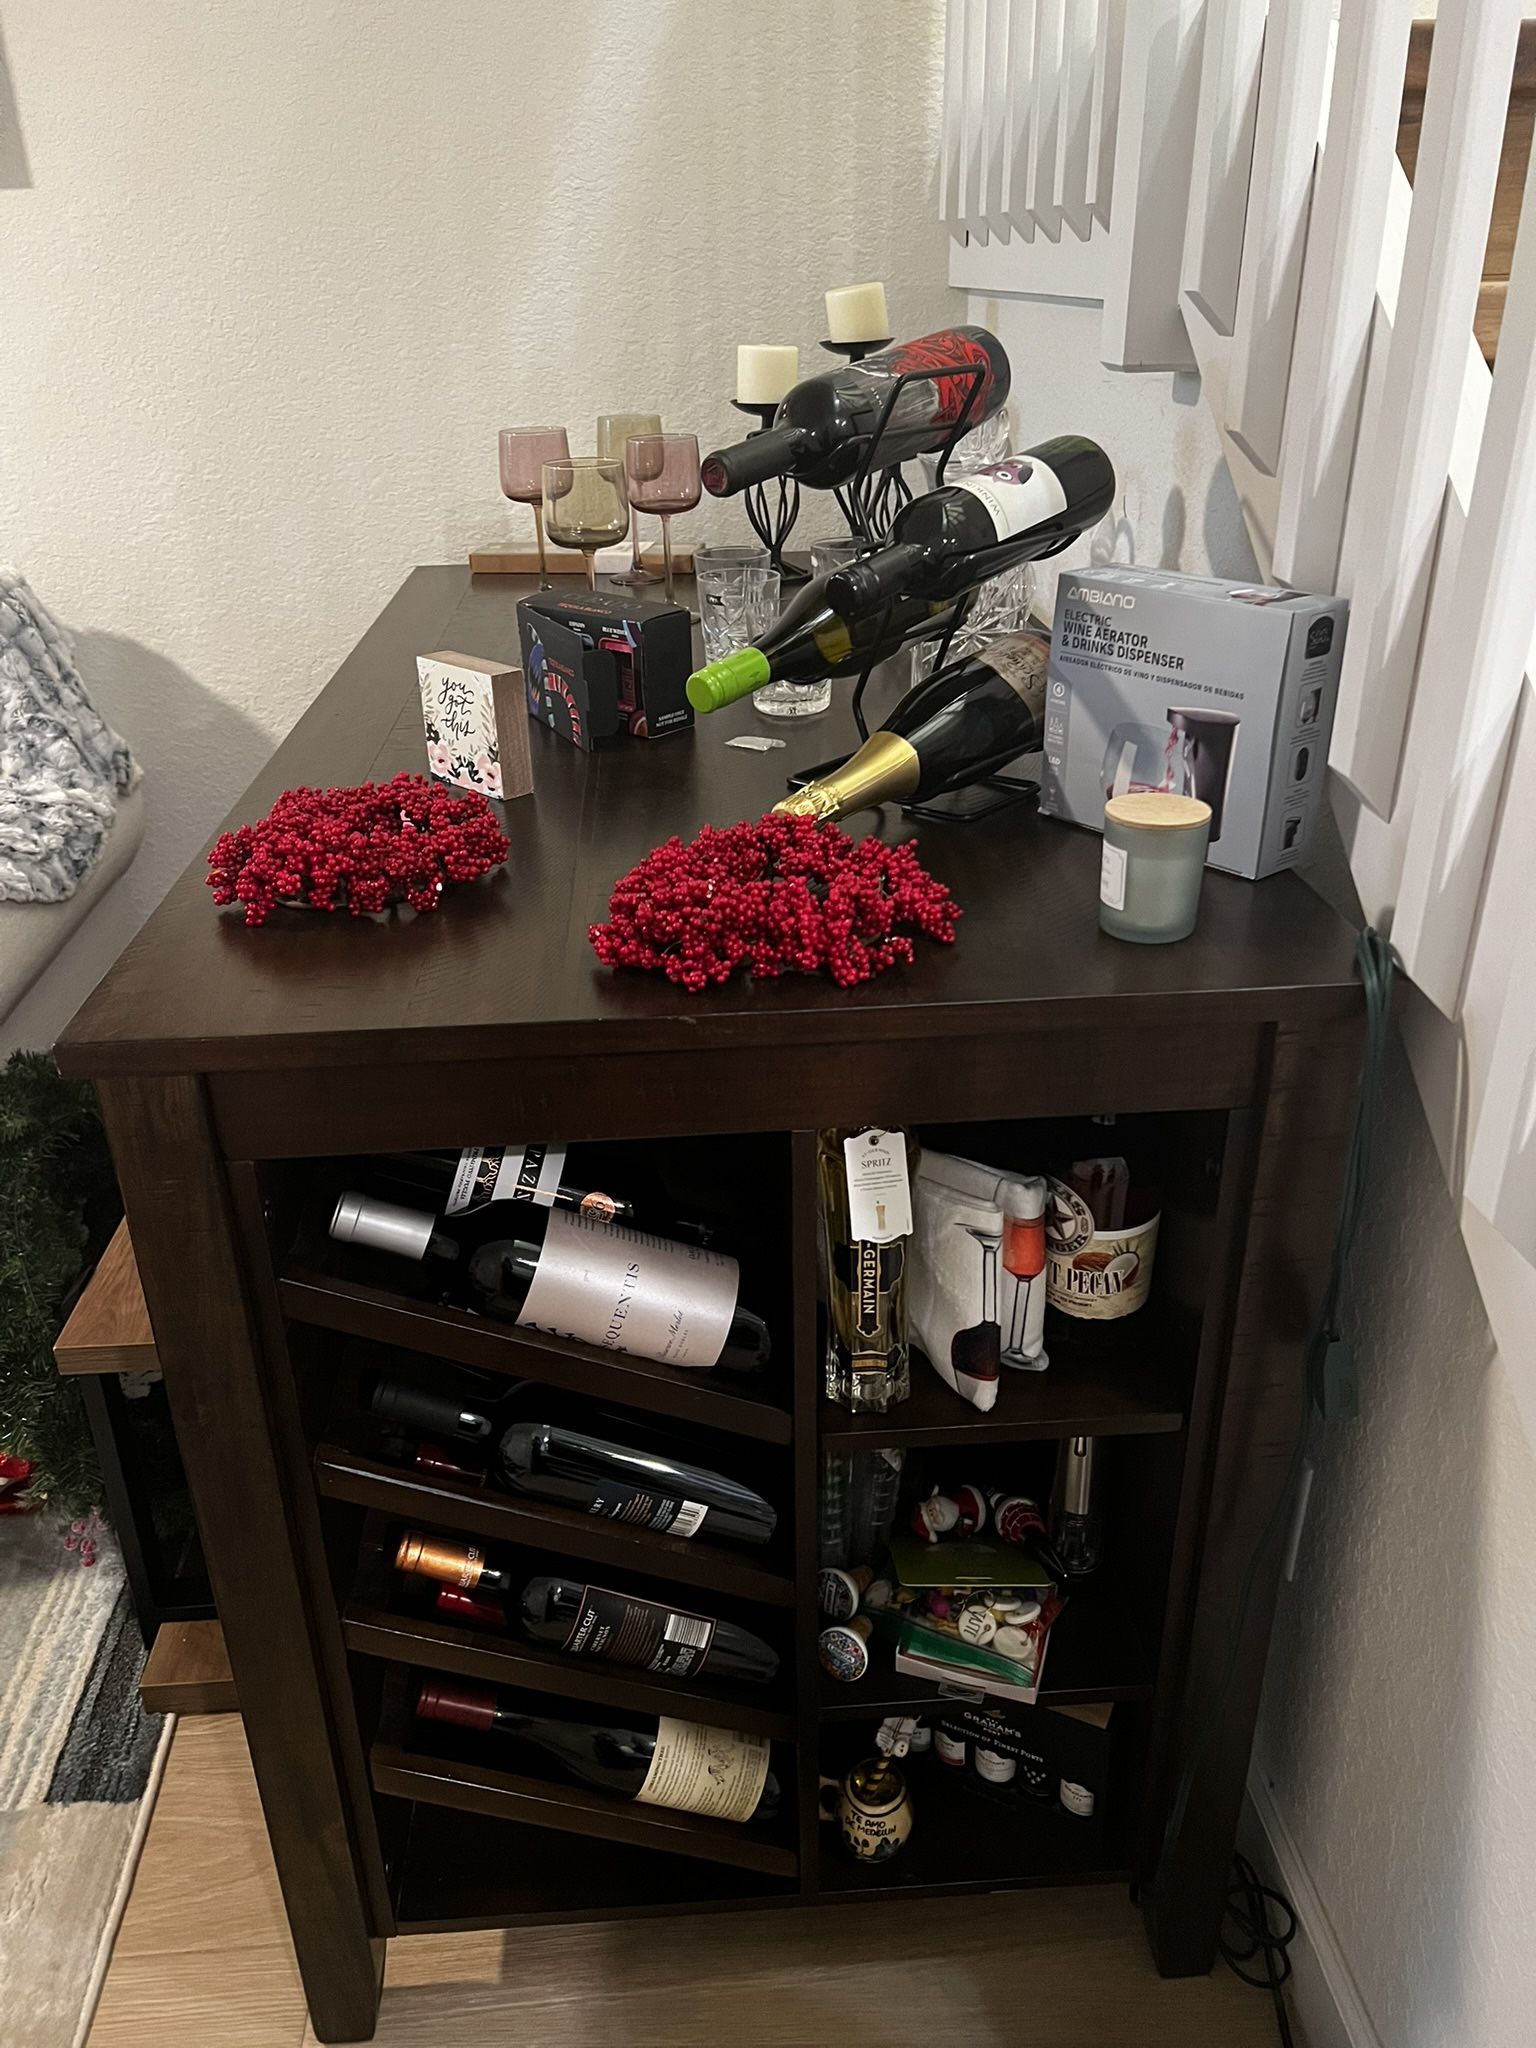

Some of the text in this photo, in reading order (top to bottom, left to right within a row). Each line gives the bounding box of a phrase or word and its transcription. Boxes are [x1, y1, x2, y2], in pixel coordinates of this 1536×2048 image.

[1067, 586, 1136, 609] AMBIANO
[1064, 609, 1112, 627] ELECTRIC
[1063, 620, 1149, 649] WINE AERATOR
[1061, 634, 1185, 671] & DRINKS DISPENSER
[437, 677, 475, 705] you
[1123, 667, 1132, 676] DE
[1133, 669, 1150, 680] VINO
[1150, 673, 1156, 681] Y
[1156, 674, 1202, 692] DISPENSADOR
[1203, 684, 1213, 694] DE
[1214, 687, 1245, 700] BEBIDAS
[445, 694, 475, 716] got
[441, 710, 476, 741] this
[861, 1157, 892, 1170] SPRITZ
[862, 1243, 877, 1314] -GERMAIN
[1066, 1267, 1124, 1297] PECAN
[582, 1609, 596, 1627] CUT
[963, 1711, 1022, 1738] GRAHAM'S
[993, 1739, 1020, 1754] FINEST
[1020, 1749, 1044, 1763] PORTS
[851, 1809, 886, 1829] TE AMO
